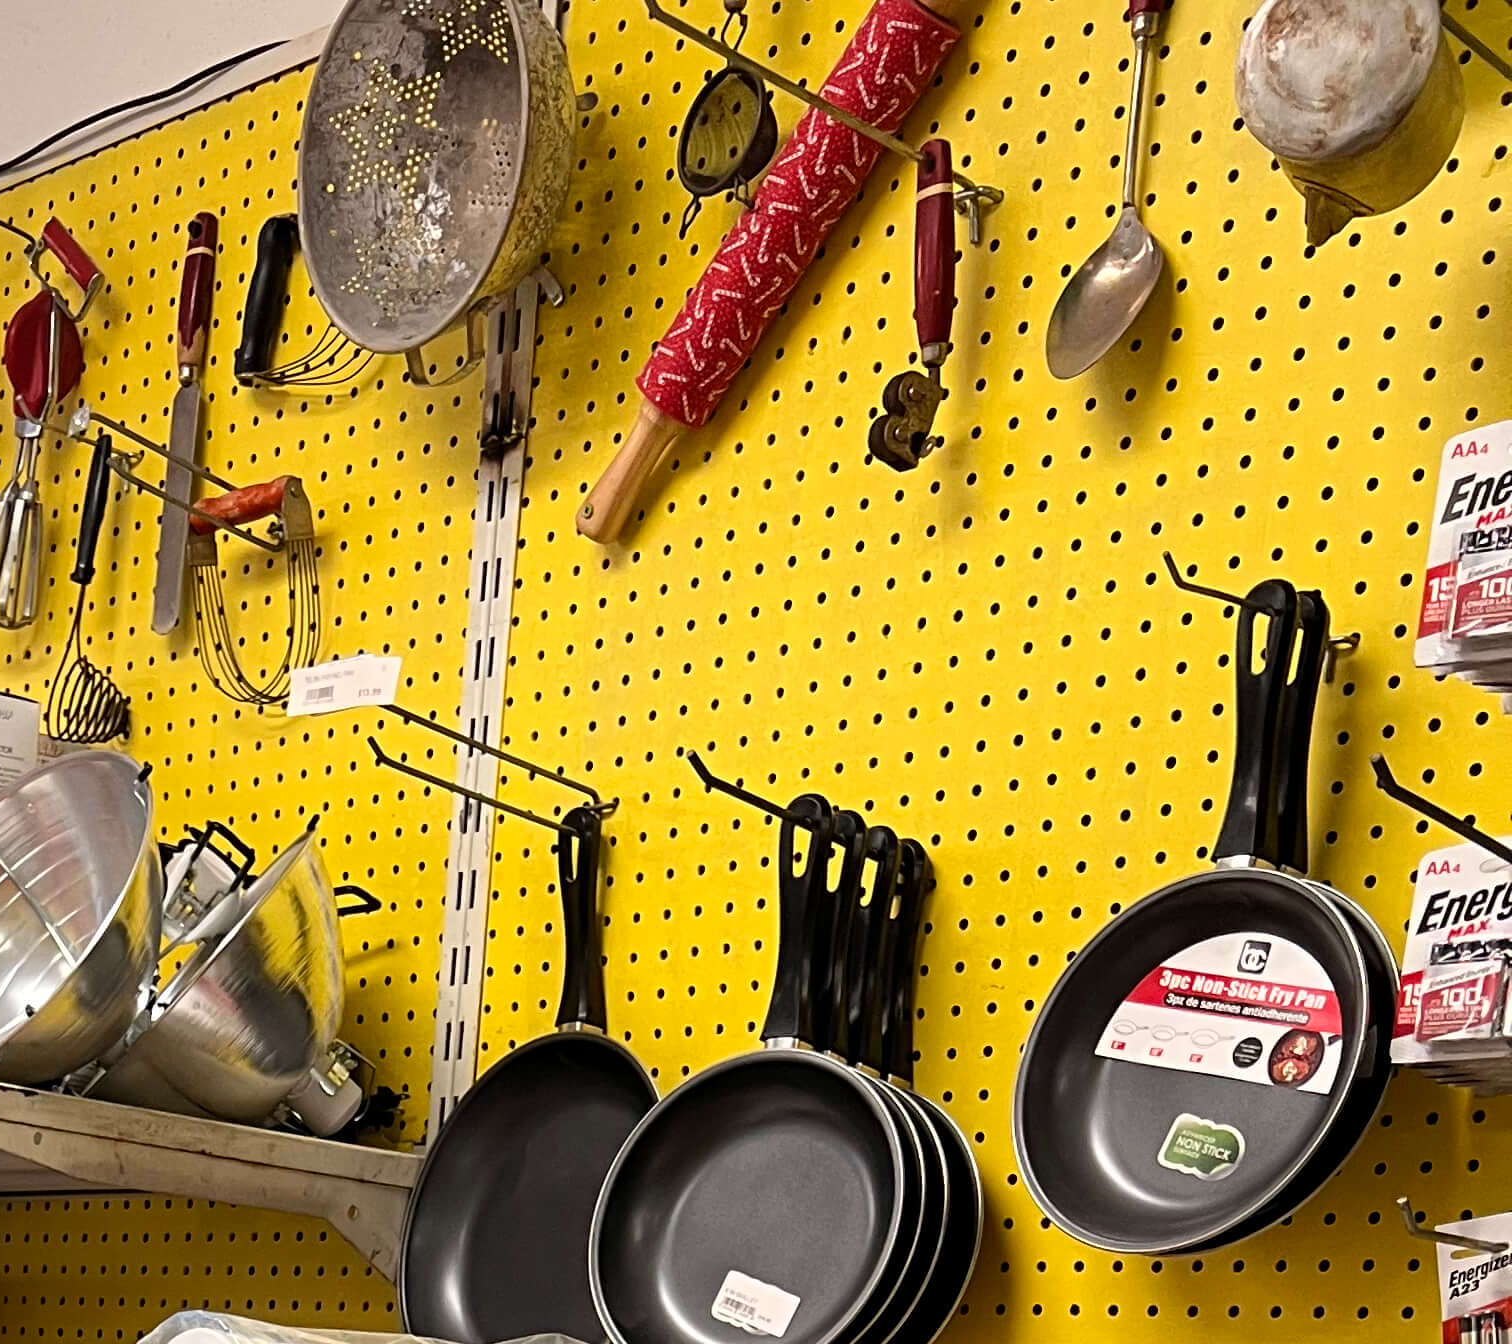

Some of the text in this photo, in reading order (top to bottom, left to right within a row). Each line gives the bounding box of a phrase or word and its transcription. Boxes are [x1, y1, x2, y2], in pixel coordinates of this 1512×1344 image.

[1159, 971, 1326, 1009] 3pc Non-Stick Fry Pan
[1449, 1279, 1480, 1300] A23
